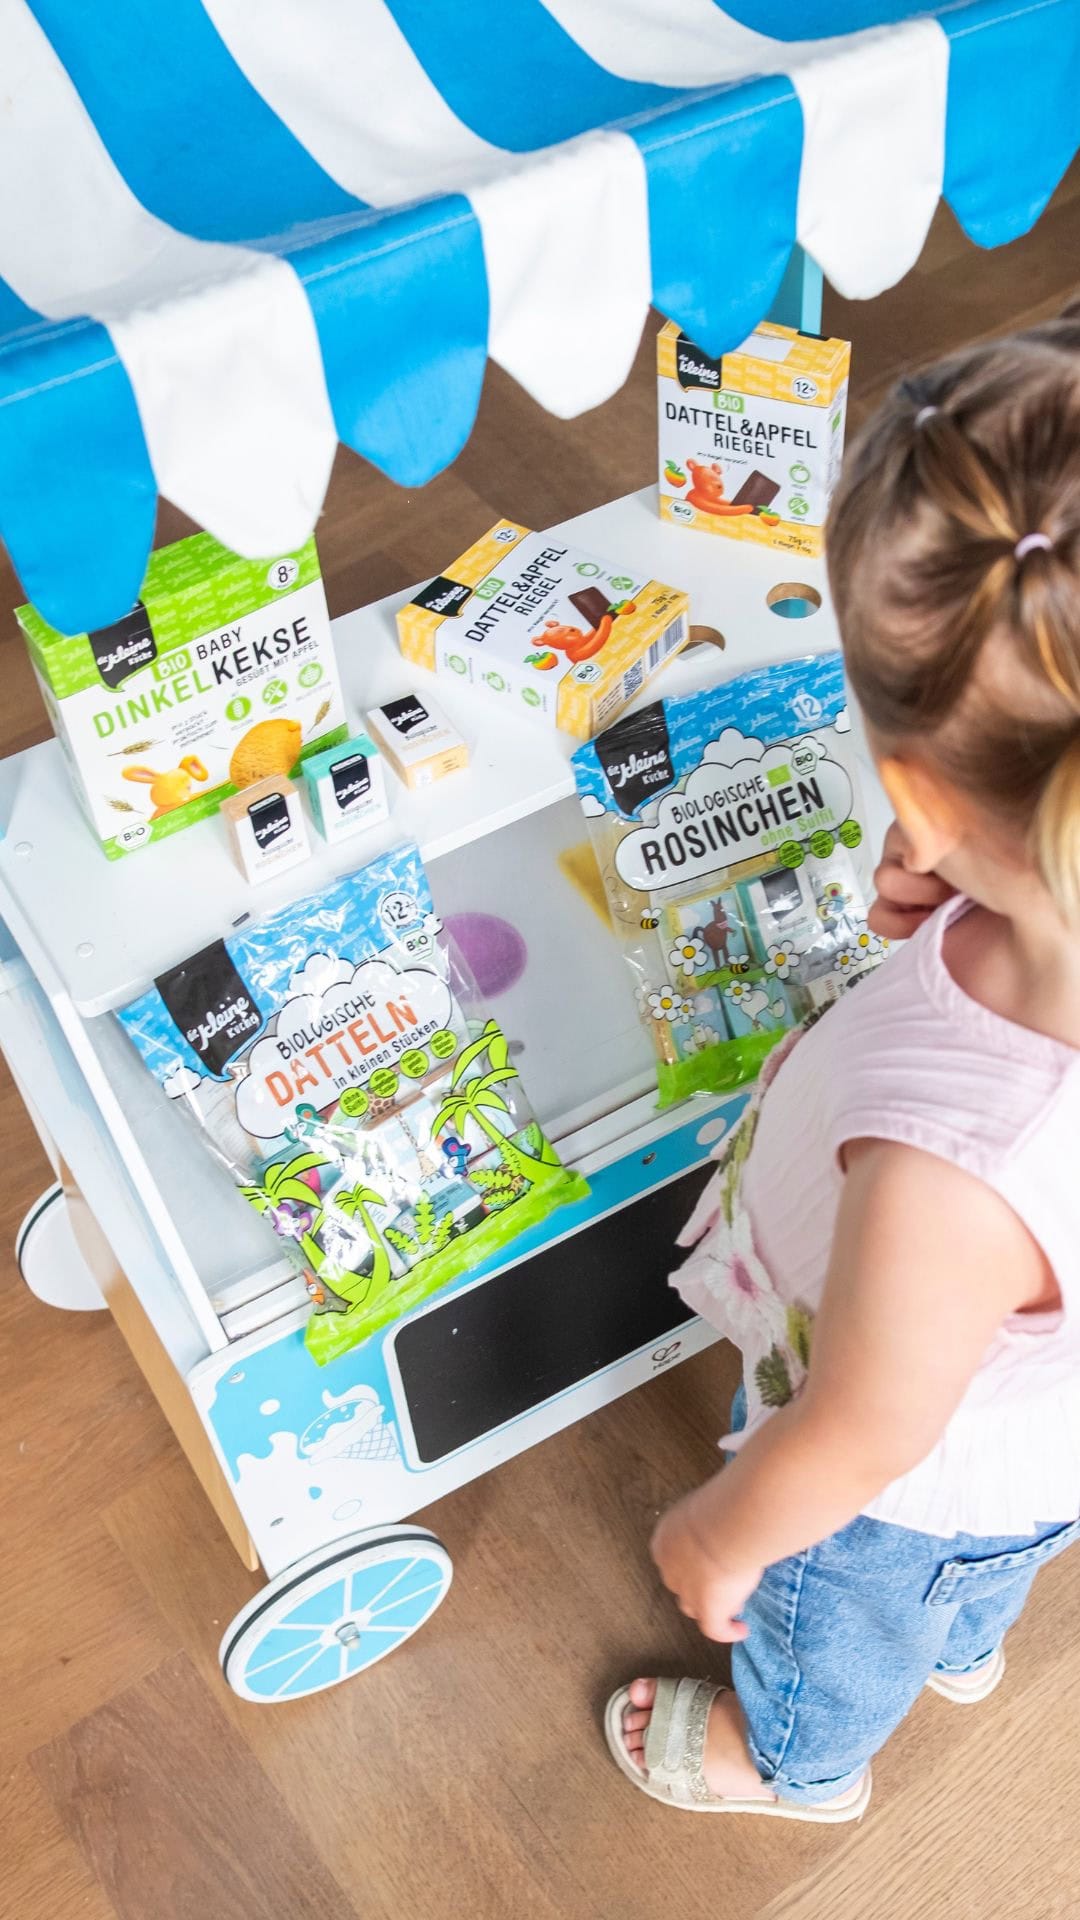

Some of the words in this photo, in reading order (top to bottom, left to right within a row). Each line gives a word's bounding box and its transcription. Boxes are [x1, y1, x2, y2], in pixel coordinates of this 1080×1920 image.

[679, 360, 719, 380] kleine
[718, 393, 741, 411] BIO
[666, 402, 817, 449] DATTEL&APFEL
[714, 433, 775, 458] RIEGEL
[464, 547, 568, 642] DATTEL&APFEL
[479, 580, 502, 599] BIO
[514, 577, 563, 616] RIEGEL
[157, 653, 187, 678] BIO
[196, 626, 241, 660] BABY
[273, 655, 290, 668] MIT
[292, 640, 319, 658] APFEL
[577, 665, 594, 679] BIO
[615, 750, 667, 788] kleine
[795, 753, 813, 766] BIO
[671, 775, 766, 825] BIOLOGISCHE
[640, 777, 825, 875] ROSINCHEN
[760, 825, 794, 846] ohne
[406, 935, 428, 952] BIO
[198, 996, 249, 1051] kleine
[276, 990, 376, 1060] BIOLOGISCHE
[265, 995, 418, 1107] DATTELN
[333, 1076, 347, 1089] in
[347, 1049, 391, 1080] kleinen
[392, 1019, 439, 1054] Stücken
